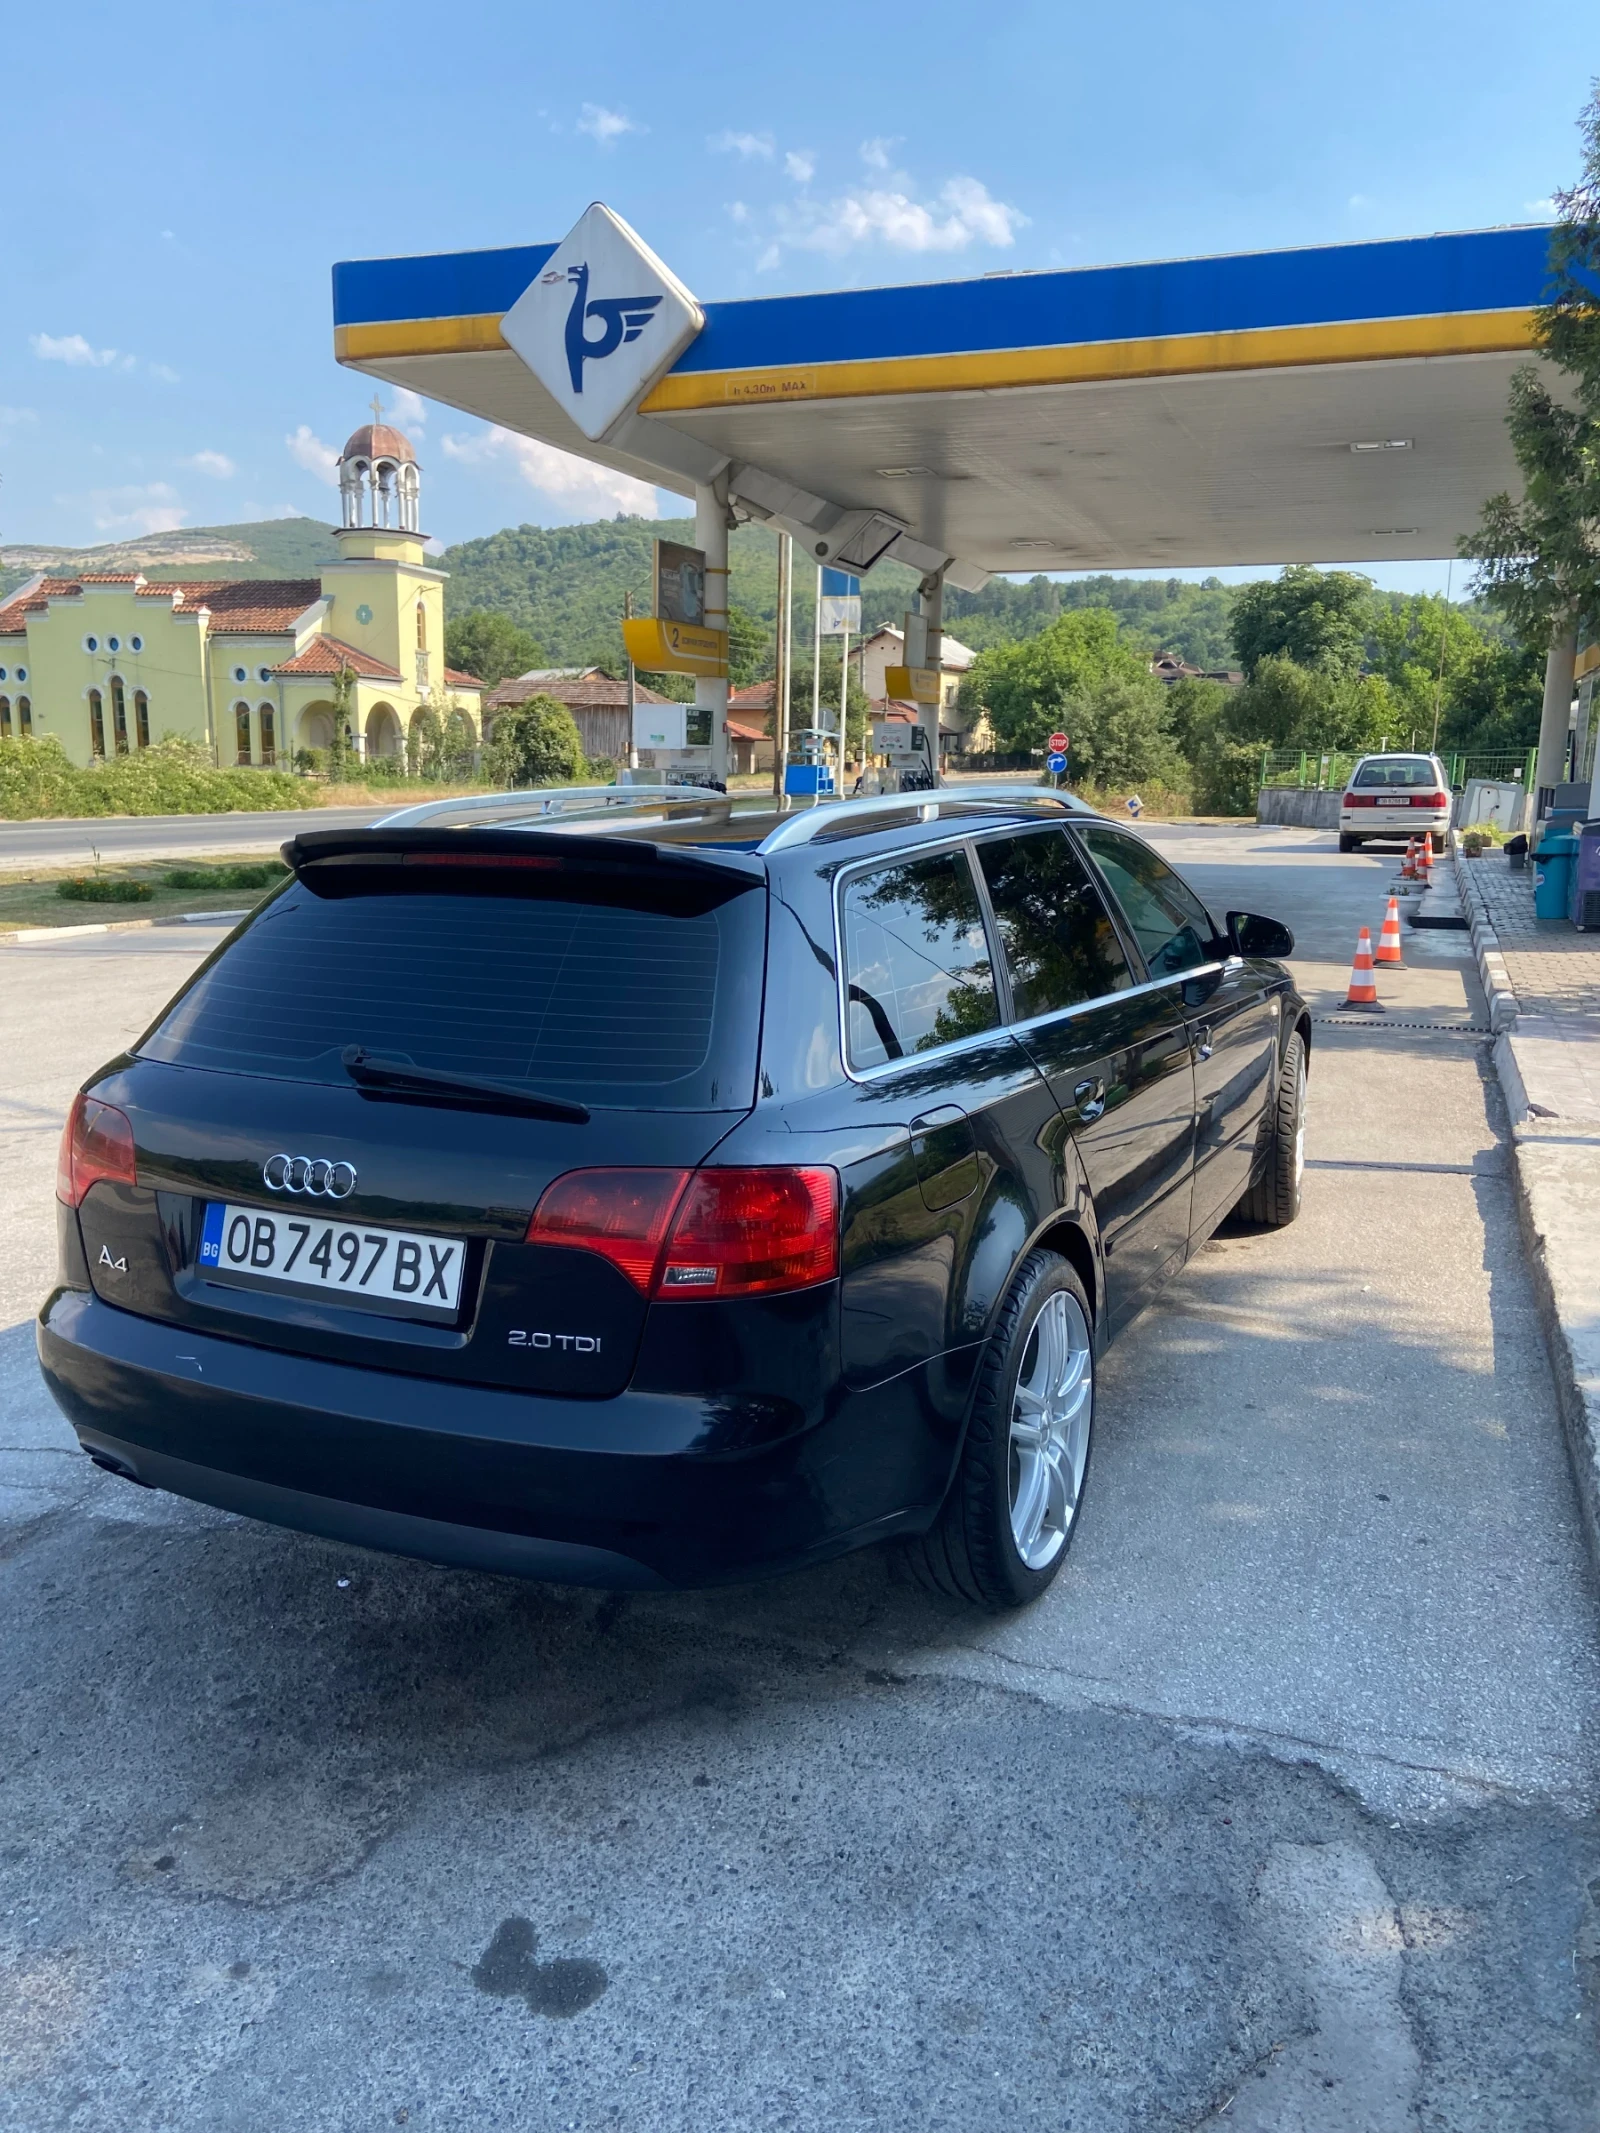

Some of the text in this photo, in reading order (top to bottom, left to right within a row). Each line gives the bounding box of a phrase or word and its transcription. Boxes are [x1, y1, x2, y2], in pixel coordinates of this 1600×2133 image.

[781, 381, 807, 392] MAX
[672, 627, 679, 648] 2
[1051, 739, 1067, 747] STOP
[99, 1244, 127, 1272] A4
[203, 1241, 219, 1257] BG
[227, 1214, 455, 1300] OB 7497 BX
[508, 1330, 601, 1353] 2.0 TDI
